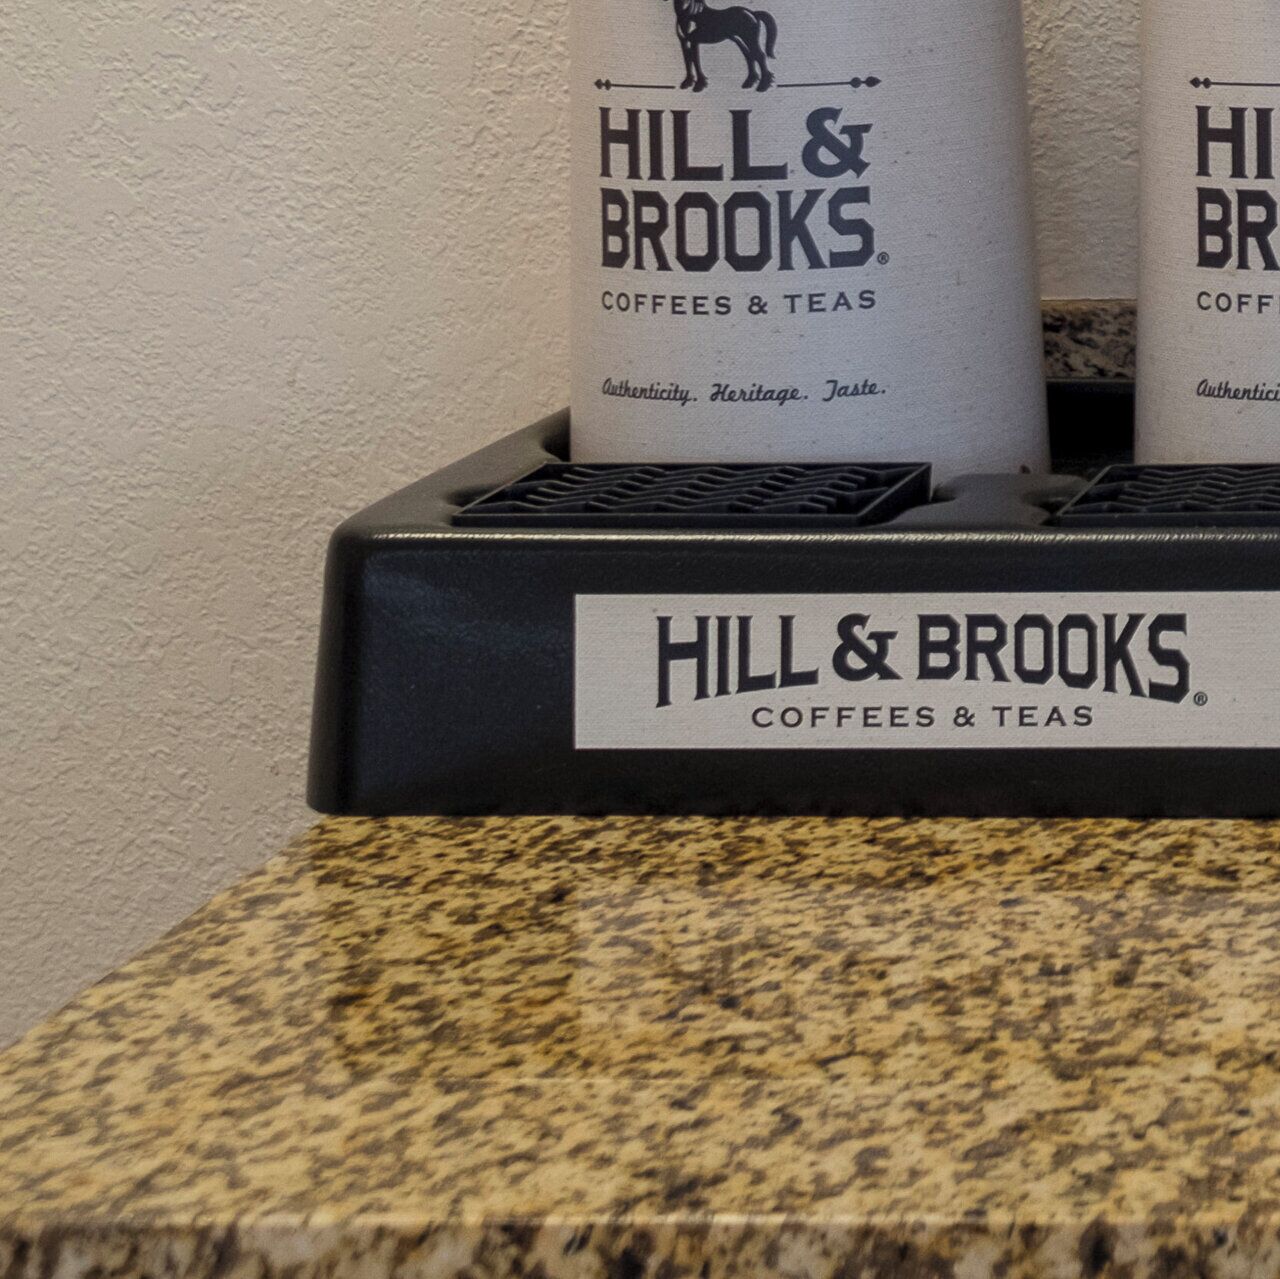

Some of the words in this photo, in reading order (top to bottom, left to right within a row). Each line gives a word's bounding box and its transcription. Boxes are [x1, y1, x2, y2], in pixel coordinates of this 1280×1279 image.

[599, 106, 788, 181] HILL
[801, 106, 873, 178] &
[601, 289, 731, 315] COFFEES
[748, 295, 768, 315] &
[784, 289, 877, 314] TEAS
[601, 377, 698, 407] Authenticity.
[709, 382, 809, 406] Heritage.
[823, 379, 887, 402] Taste.
[655, 614, 819, 709] HILL
[831, 612, 903, 682] &
[751, 706, 936, 729] COFFEES
[953, 706, 977, 729] &
[993, 705, 1095, 728] TEAS
